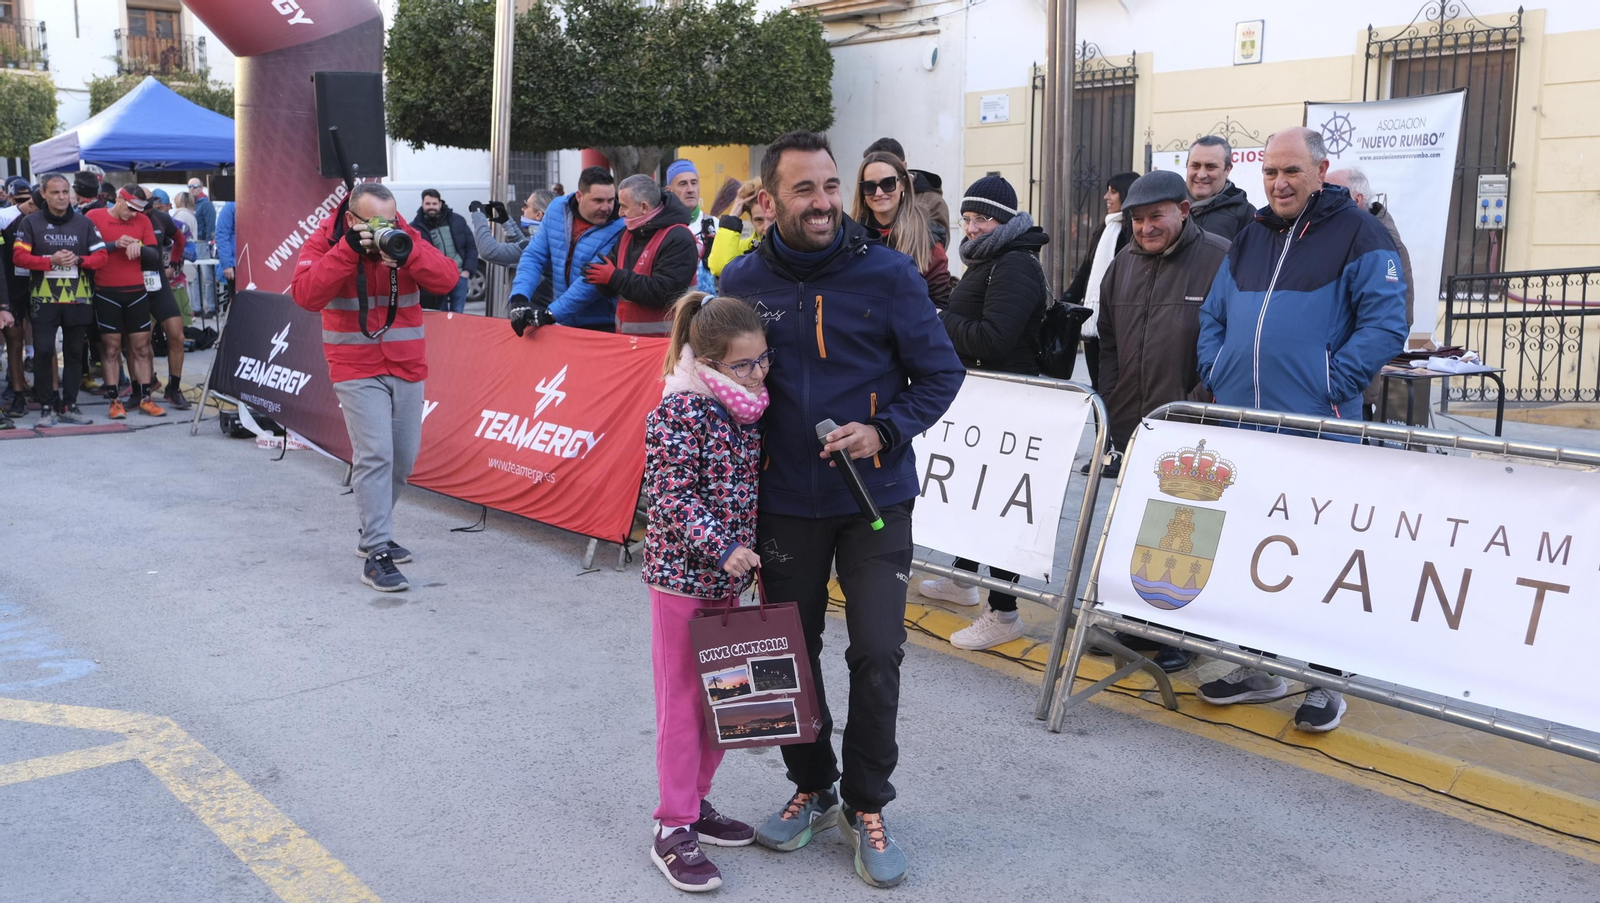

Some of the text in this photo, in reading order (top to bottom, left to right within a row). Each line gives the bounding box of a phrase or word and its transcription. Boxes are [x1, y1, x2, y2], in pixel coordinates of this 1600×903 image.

[271, 0, 315, 26] GY
[1377, 117, 1427, 131] ASOCIACION
[1359, 152, 1441, 161] www.asociacionnuevorumbo.com
[234, 355, 312, 396] TEAMERGY
[474, 409, 605, 460] TEAMERGY
[1000, 431, 1043, 462] DE
[920, 453, 1034, 525] RIA
[1267, 493, 1600, 571] AYUNTAM
[1250, 535, 1571, 646] CANT
[699, 637, 789, 664] ¡VIVE CANTORIA!
